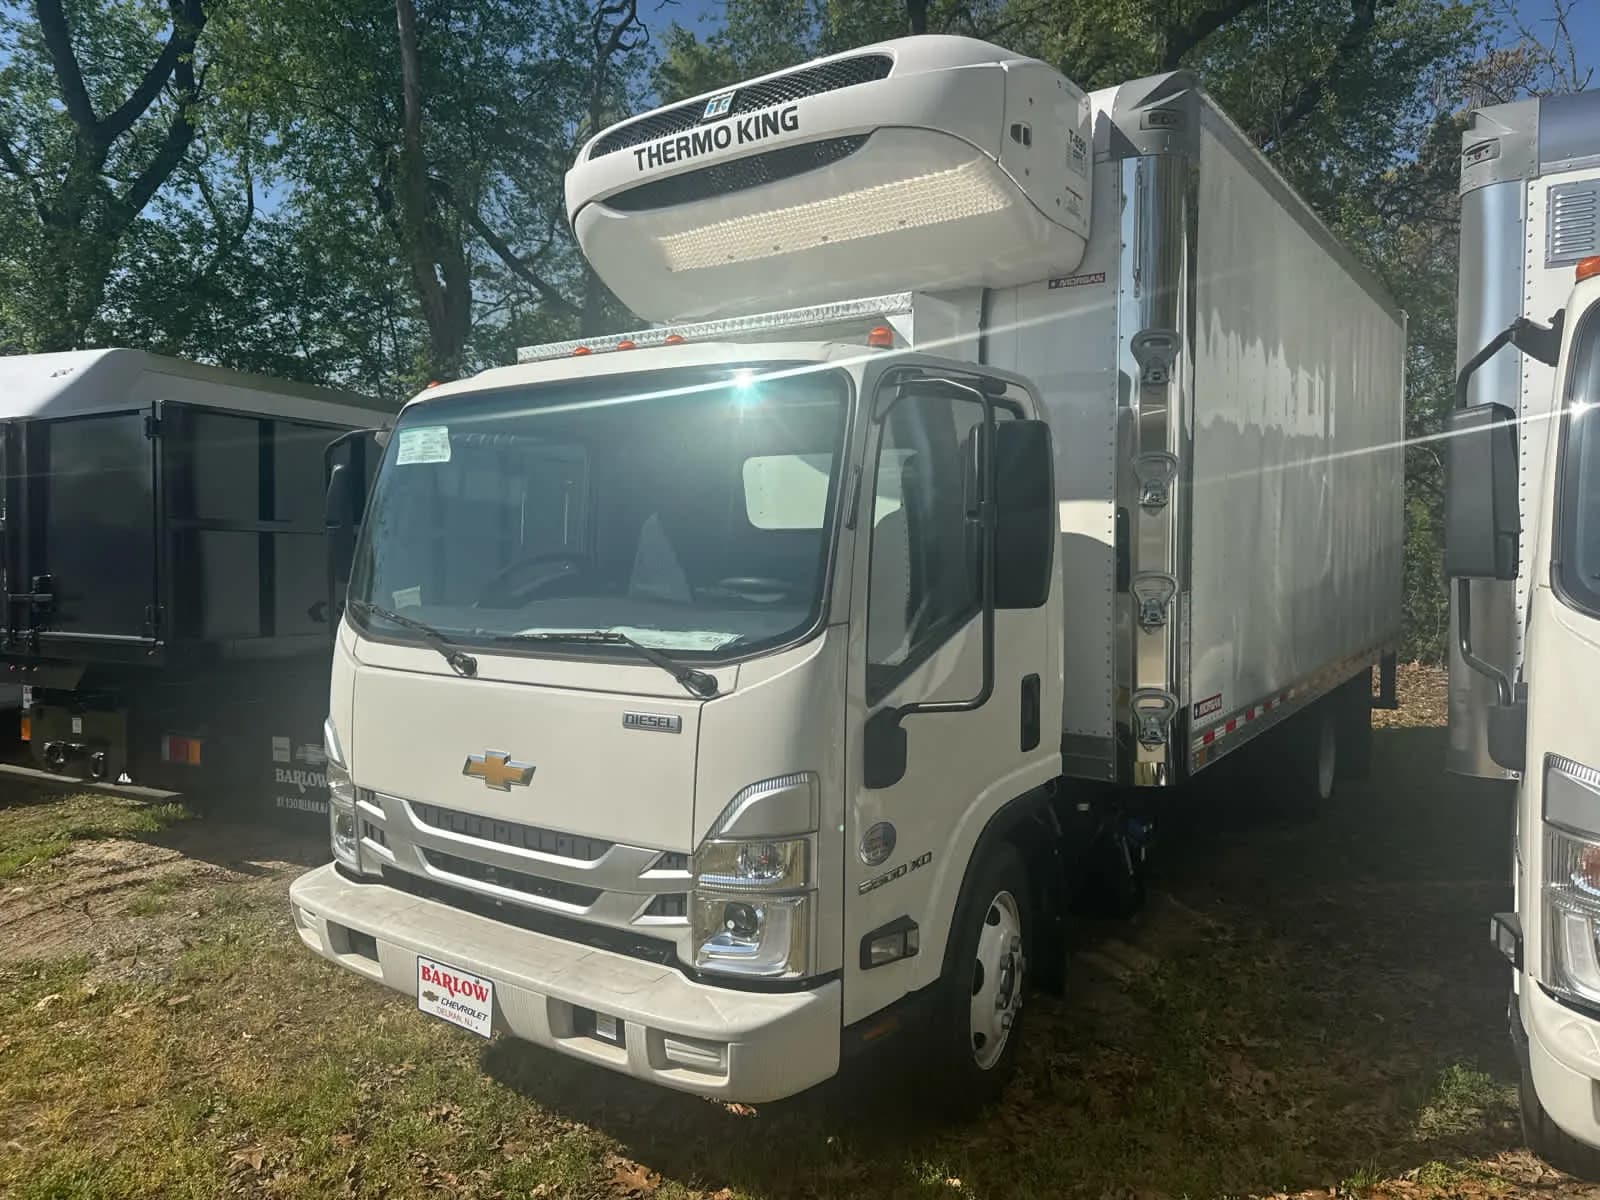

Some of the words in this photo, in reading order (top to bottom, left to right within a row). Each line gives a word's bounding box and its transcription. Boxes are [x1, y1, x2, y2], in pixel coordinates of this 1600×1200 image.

[633, 126, 732, 171] THERMO
[736, 106, 799, 144] KING
[625, 713, 674, 729] DIESEL
[275, 767, 328, 794] BARLOW
[421, 965, 489, 1003] BARLOW
[440, 997, 489, 1022] CHEVROLET
